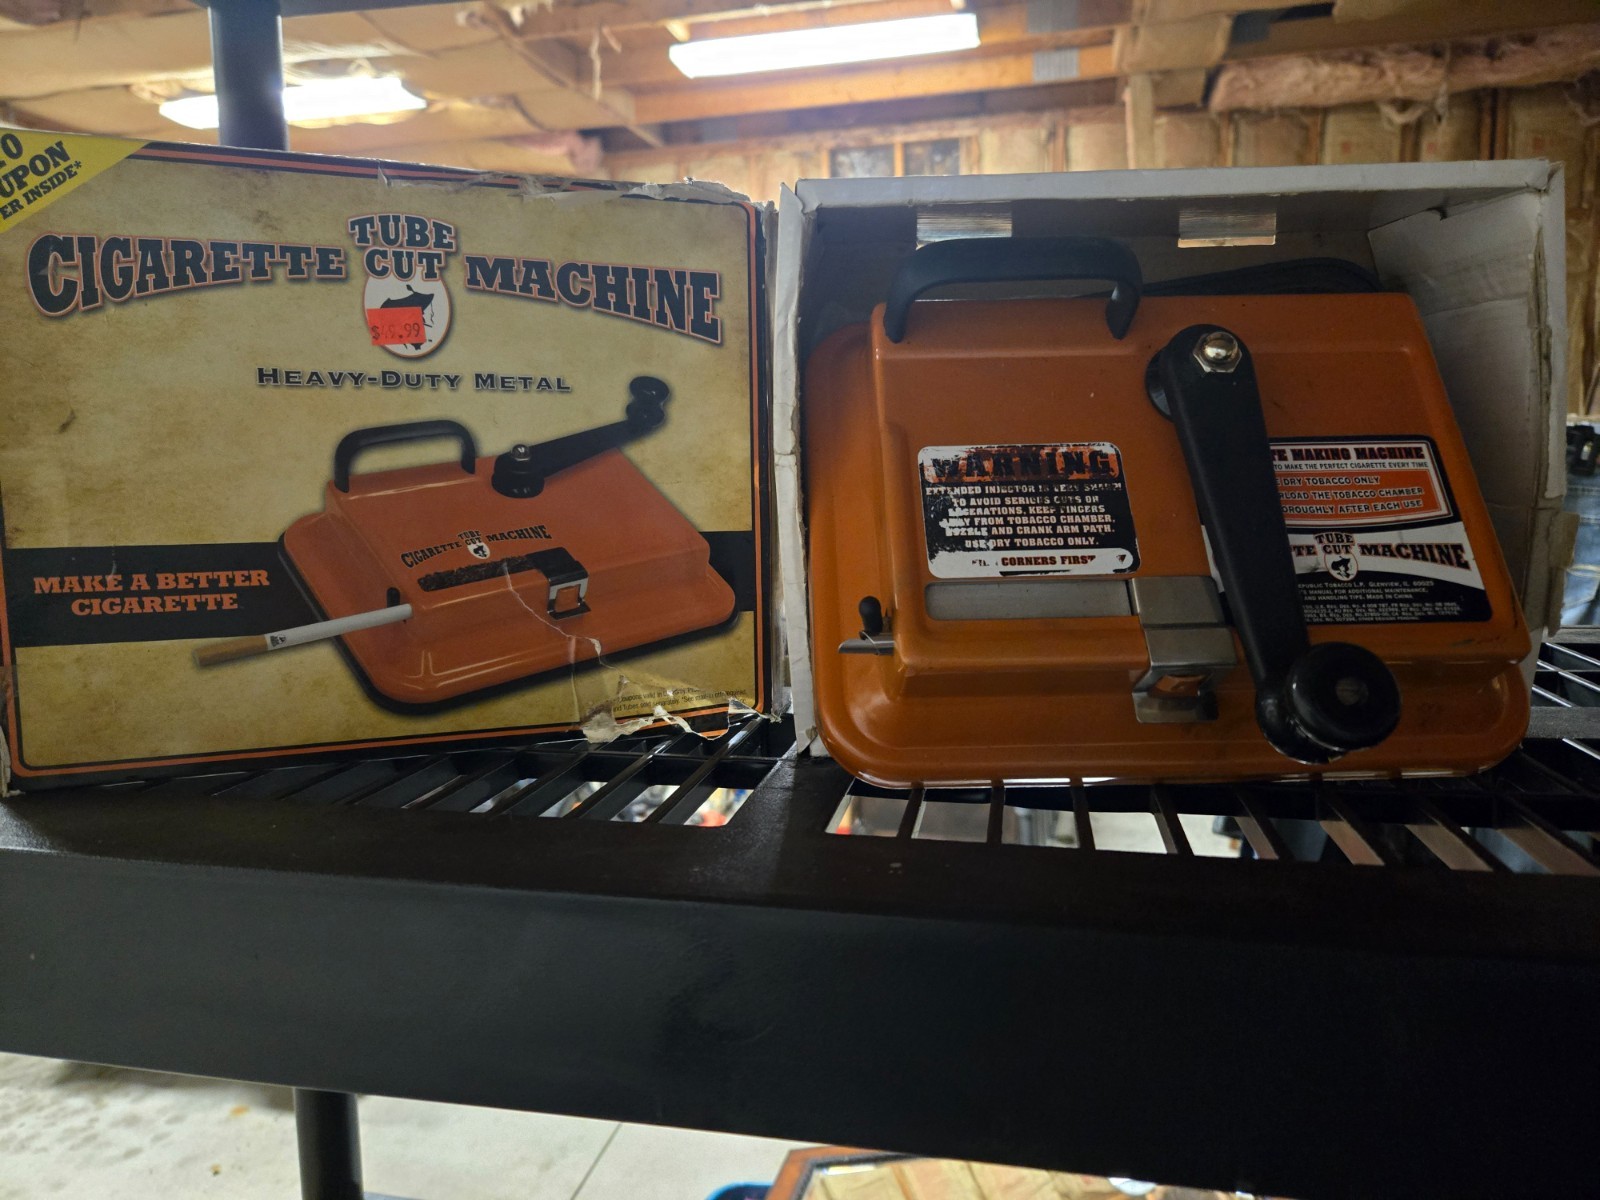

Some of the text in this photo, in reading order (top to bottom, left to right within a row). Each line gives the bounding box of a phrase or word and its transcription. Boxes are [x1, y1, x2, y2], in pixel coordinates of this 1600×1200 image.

[348, 213, 457, 251] TUBE
[27, 234, 722, 345] CIGARETTE CUT MACHINE
[256, 367, 572, 393] HEAVY-DUTY METAL
[1290, 447, 1352, 461] MAKING
[1353, 446, 1426, 460] MACHINE
[1283, 478, 1302, 486] DRY
[1305, 477, 1351, 486] TOBACCO
[1353, 476, 1380, 485] ONLY
[970, 496, 1002, 506] AVOID
[1004, 495, 1051, 505] SERIOUS
[1053, 495, 1082, 504] CUTS
[1084, 494, 1100, 504] OR
[1311, 491, 1331, 500] THE
[1332, 489, 1377, 500] TOBACCO
[1378, 487, 1424, 497] CHAMBER
[1339, 504, 1371, 514] AFTER
[1373, 502, 1400, 511] EACH
[1402, 500, 1423, 508] USE
[973, 517, 1005, 526] FROM
[1007, 515, 1057, 525] TOBACCO
[991, 526, 1014, 535] AND
[1016, 525, 1053, 535] CRANK
[1056, 525, 1080, 534] ARM
[1082, 523, 1116, 533] PATH.
[988, 538, 1011, 549] DRY
[1014, 537, 1065, 548] TOBACCO
[1067, 536, 1100, 546] ONLY.
[1314, 532, 1355, 545] TUBE
[401, 524, 552, 569] CIGARETTE CUT MACHINE
[1001, 556, 1058, 567] CORNERS
[1322, 543, 1352, 555] CUT
[1357, 543, 1472, 571] MACHINE
[33, 569, 270, 595] MAKE A BETTER
[71, 592, 239, 617] CIGARETTE
